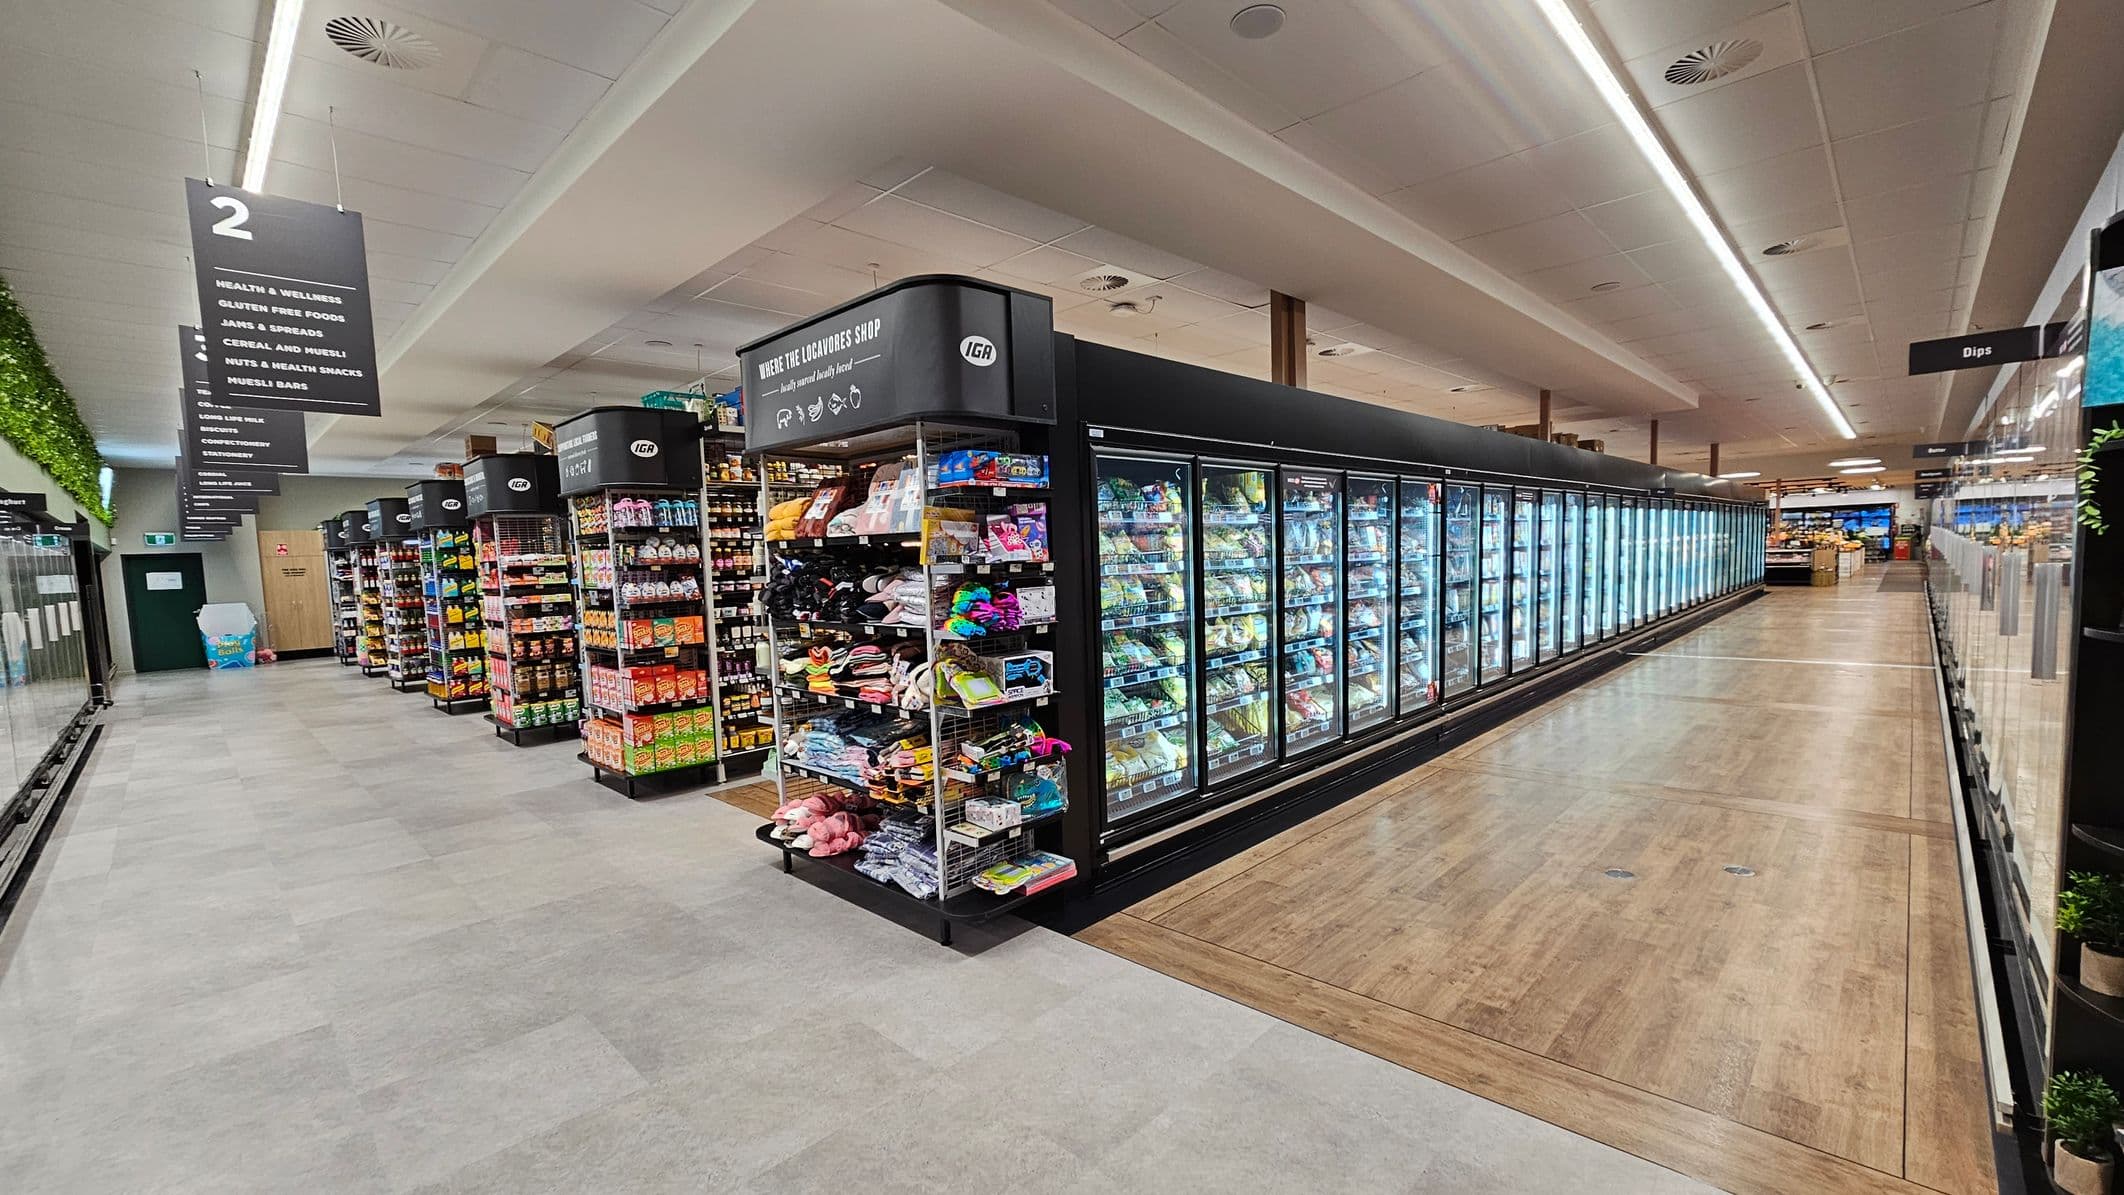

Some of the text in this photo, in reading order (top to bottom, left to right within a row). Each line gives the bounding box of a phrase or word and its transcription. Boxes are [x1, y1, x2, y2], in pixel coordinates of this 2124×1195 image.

[210, 196, 253, 240] 2
[216, 280, 343, 305] HEALTH & WELLNESS
[218, 299, 346, 323] GLUTEN FREE FOODS
[221, 319, 324, 338] JAMS & SPREADS
[223, 338, 346, 358] CEREAL AND MUESLI
[759, 318, 881, 380] WHERE THE LOCAVORES SHOP
[966, 341, 993, 361] IGA
[1962, 346, 1993, 360] Dips
[225, 357, 363, 378] NUTS & HEALTH SNACKS
[780, 358, 853, 393] locally sourced locally loved
[227, 376, 309, 391] MUESLI BARS
[198, 413, 265, 424] LONG LIFE MILK
[200, 425, 239, 434] BISCUITS
[201, 438, 271, 448] CONFECTIONERY
[634, 443, 655, 454] IGA
[202, 450, 254, 459] STATIONERY
[510, 480, 528, 489] IGA
[444, 501, 459, 509] IGA
[218, 646, 244, 656] Balls
